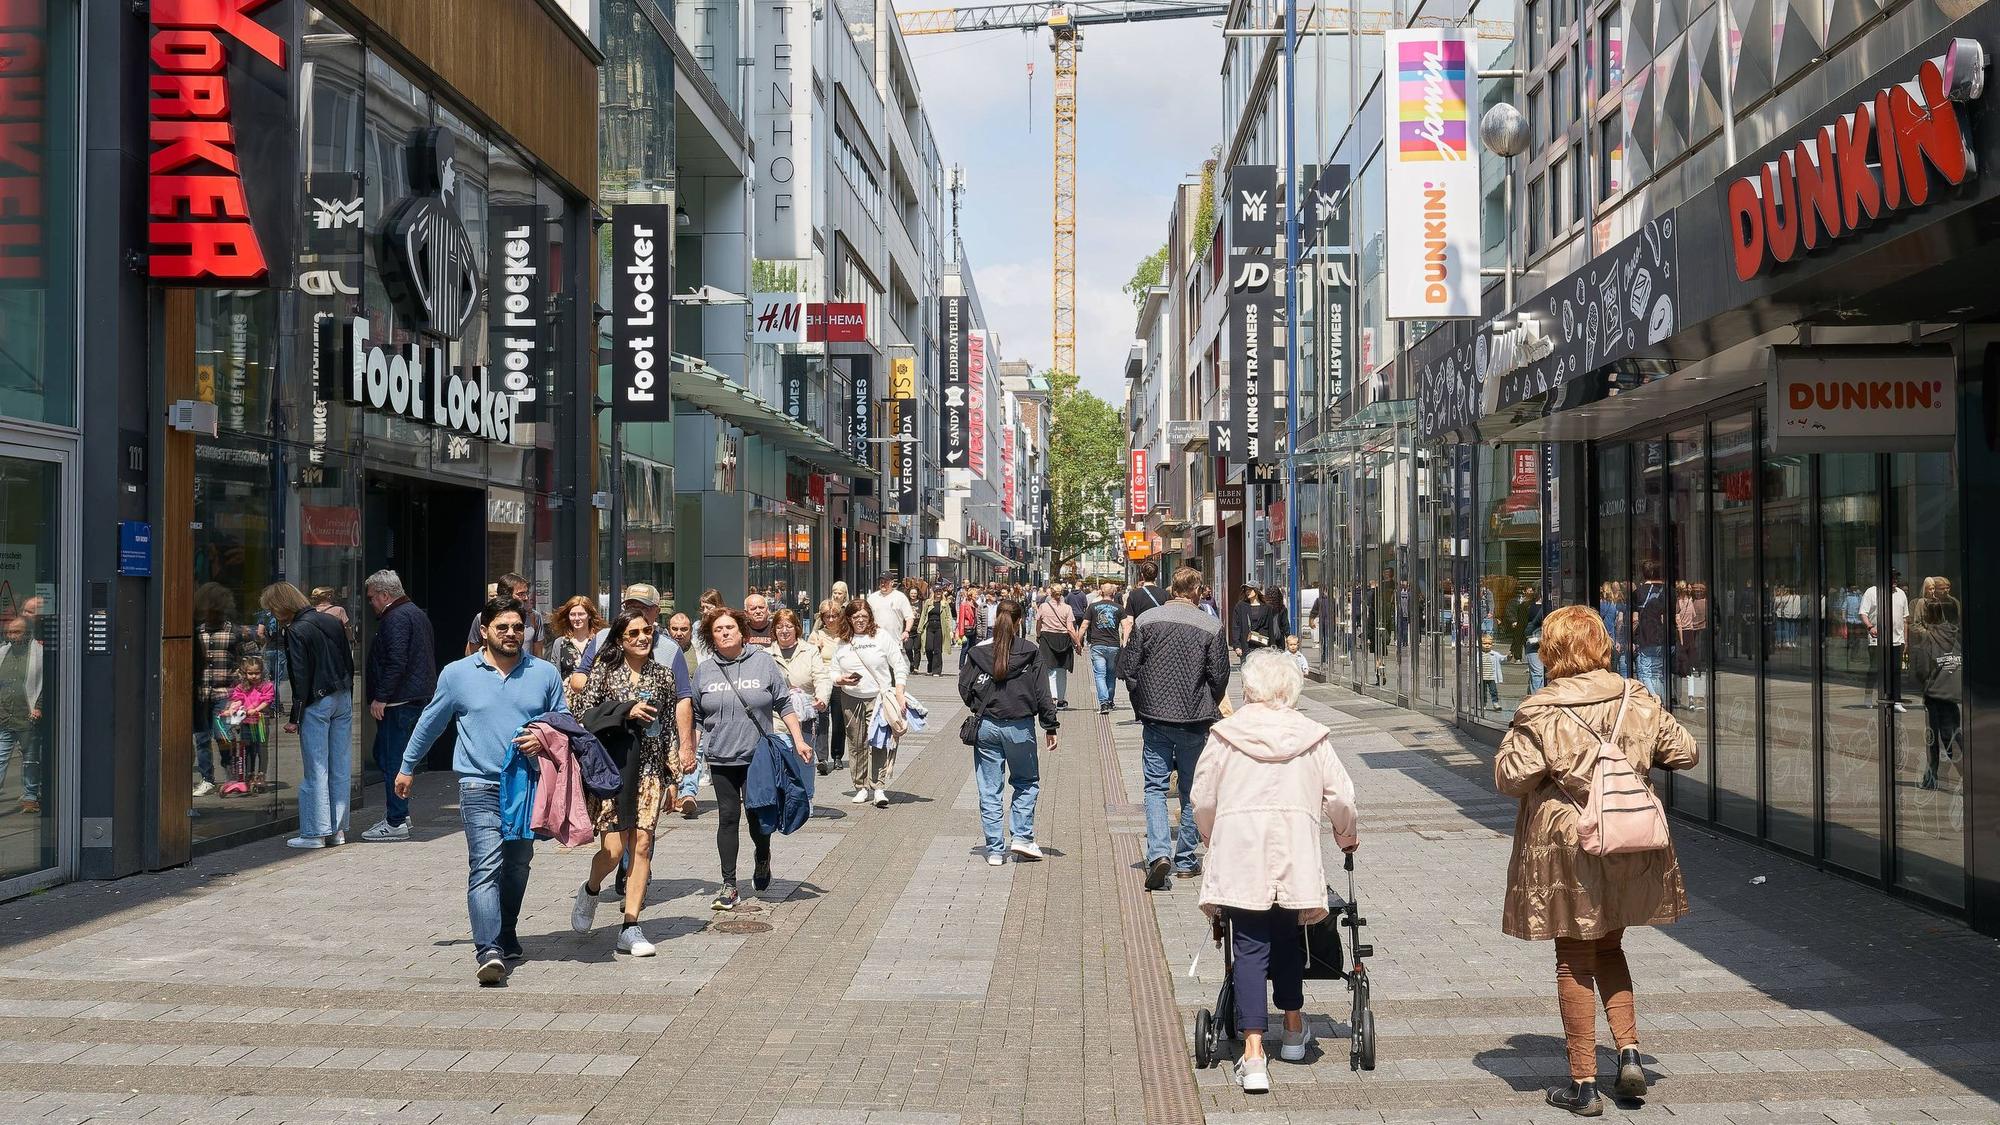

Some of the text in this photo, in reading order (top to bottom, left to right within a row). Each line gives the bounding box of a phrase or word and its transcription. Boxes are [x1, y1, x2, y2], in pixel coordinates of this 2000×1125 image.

[149, 0, 284, 278] YORKER
[1728, 38, 1972, 282] DUNKIN'
[1242, 191, 1267, 221] WMF
[1424, 182, 1448, 303] DUNKIN'
[1234, 263, 1269, 287] JD
[627, 225, 654, 401] Foot Locker
[757, 303, 802, 333] H&M
[829, 315, 863, 325] HEMA
[353, 316, 423, 419] Foot
[434, 347, 519, 445] Locker
[949, 298, 959, 446] SANDY LEDERATELIER
[1247, 304, 1258, 433] KING OF TRAINERS
[1789, 381, 1942, 410] DUNKIN'
[903, 415, 912, 454] MDA
[1217, 425, 1231, 451] WM
[129, 446, 142, 471] 111
[903, 458, 912, 493] VERO
[1031, 475, 1039, 523] HOTEL
[1218, 489, 1241, 497] ELBEN
